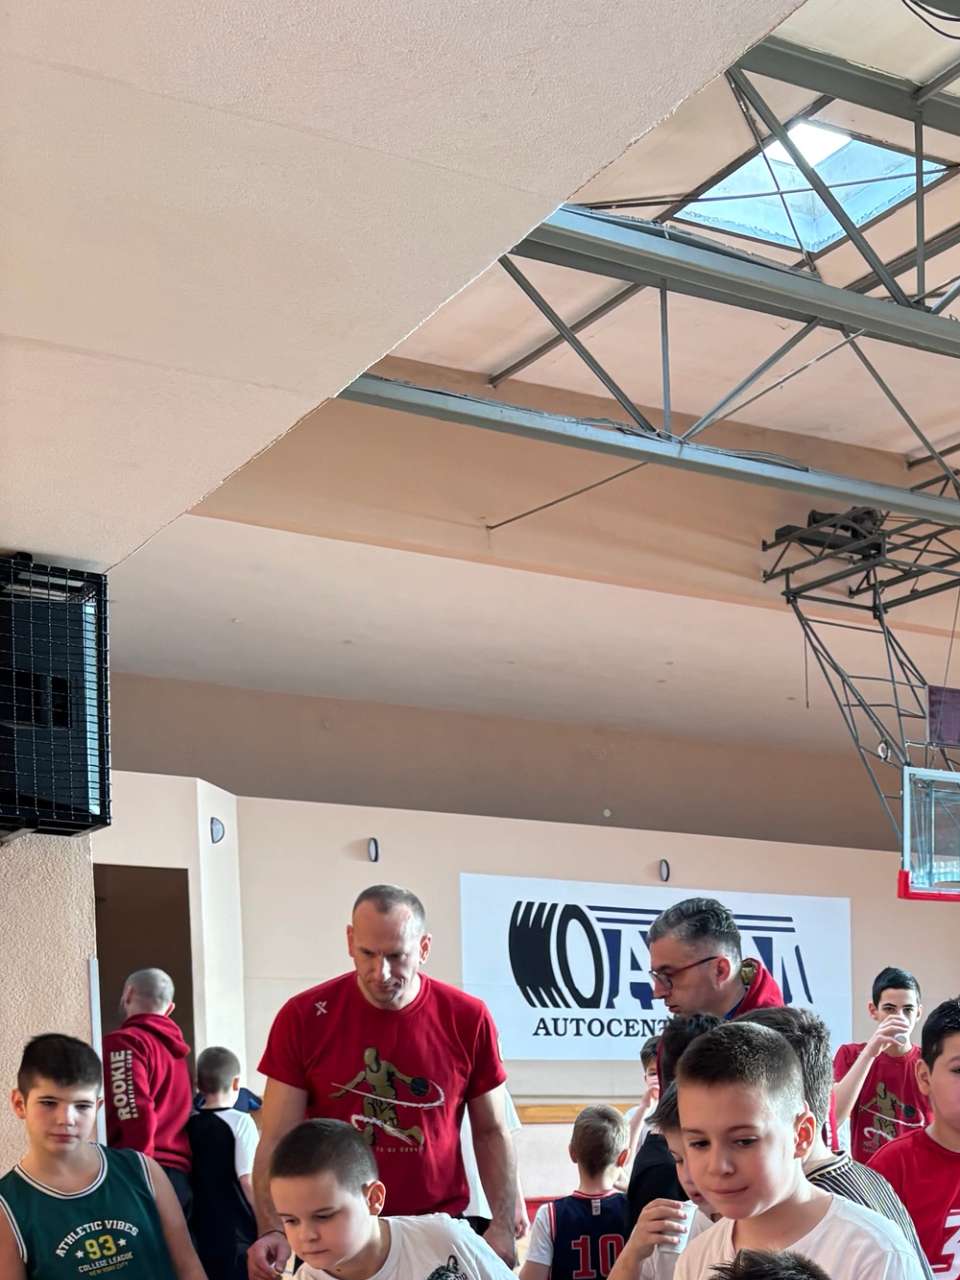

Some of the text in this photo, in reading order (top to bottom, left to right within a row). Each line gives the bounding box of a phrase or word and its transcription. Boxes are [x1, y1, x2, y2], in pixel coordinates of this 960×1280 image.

[110, 1050, 132, 1120] ROOKIE
[56, 1220, 139, 1258] ATHLETIC VIBES
[84, 1235, 118, 1260] 93
[571, 1234, 625, 1280] 10
